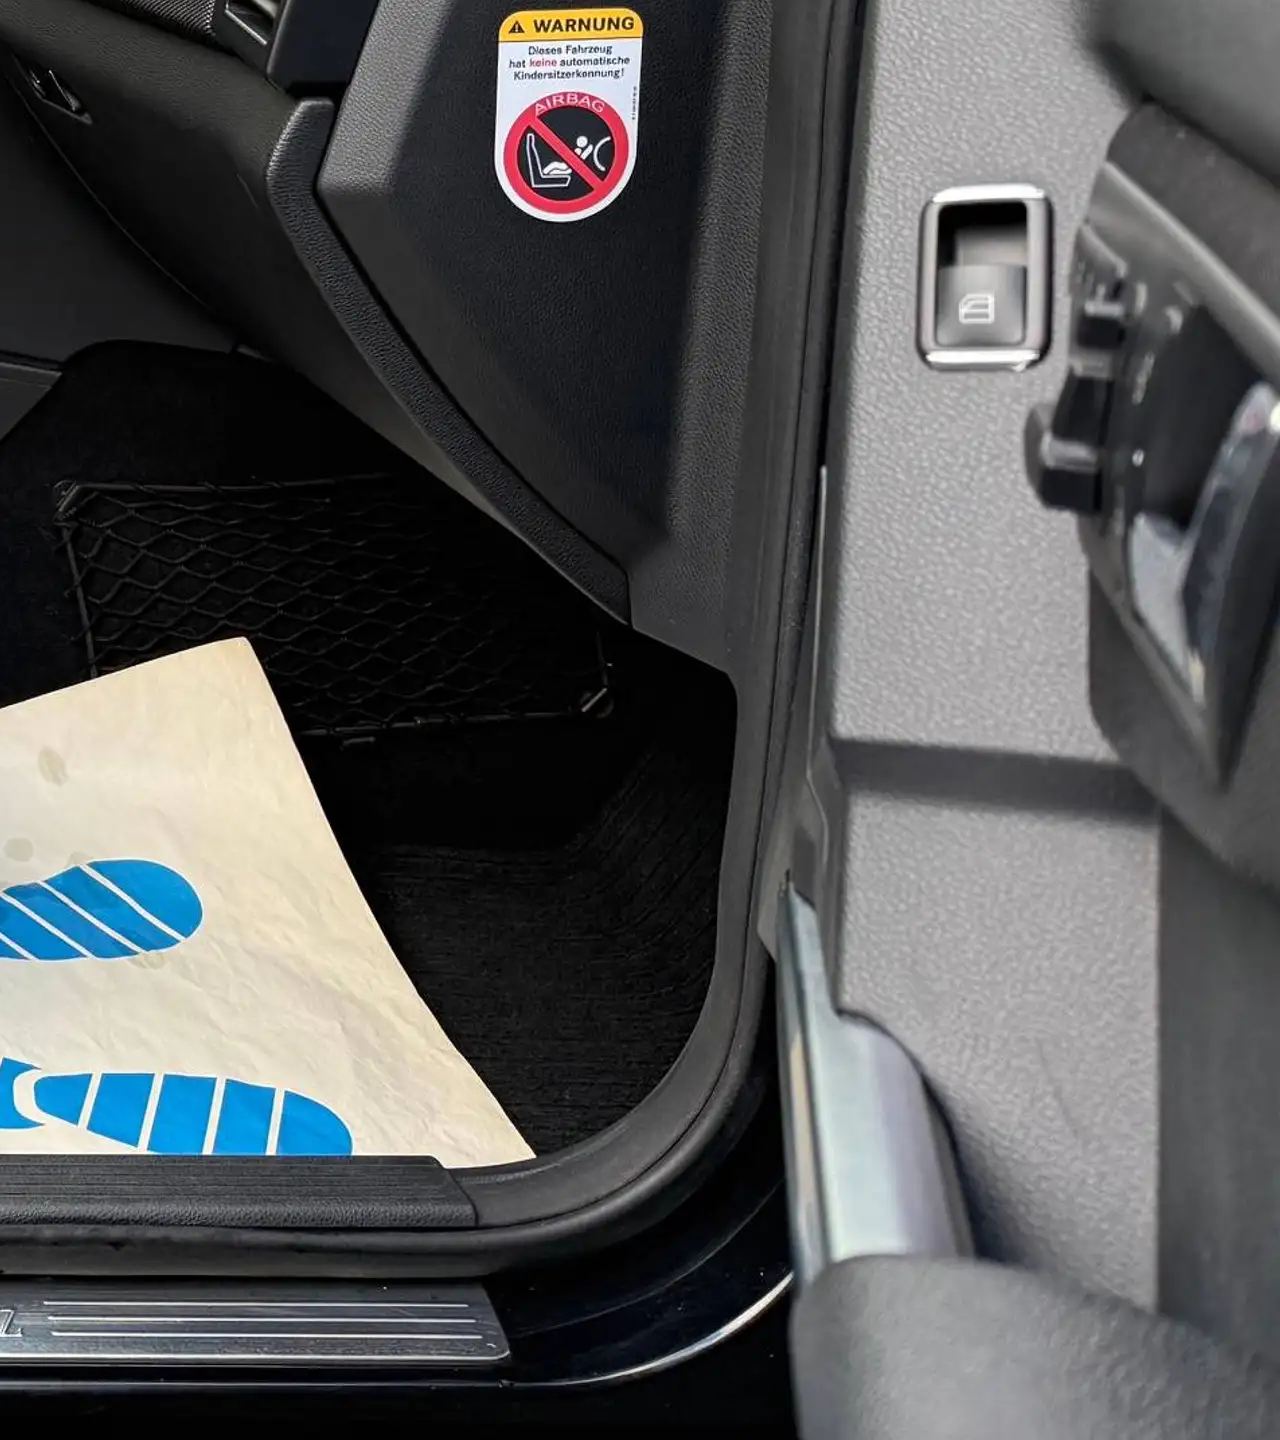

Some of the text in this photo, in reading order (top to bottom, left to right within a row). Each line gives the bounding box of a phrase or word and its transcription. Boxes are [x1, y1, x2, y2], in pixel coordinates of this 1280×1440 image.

[533, 16, 635, 33] WARNUNG
[528, 45, 613, 56] Dieses Fahrzeug
[509, 56, 630, 69] hat keine automatische
[514, 68, 625, 80] Kindersitzerkennung!
[535, 92, 605, 117] AIRBAG
